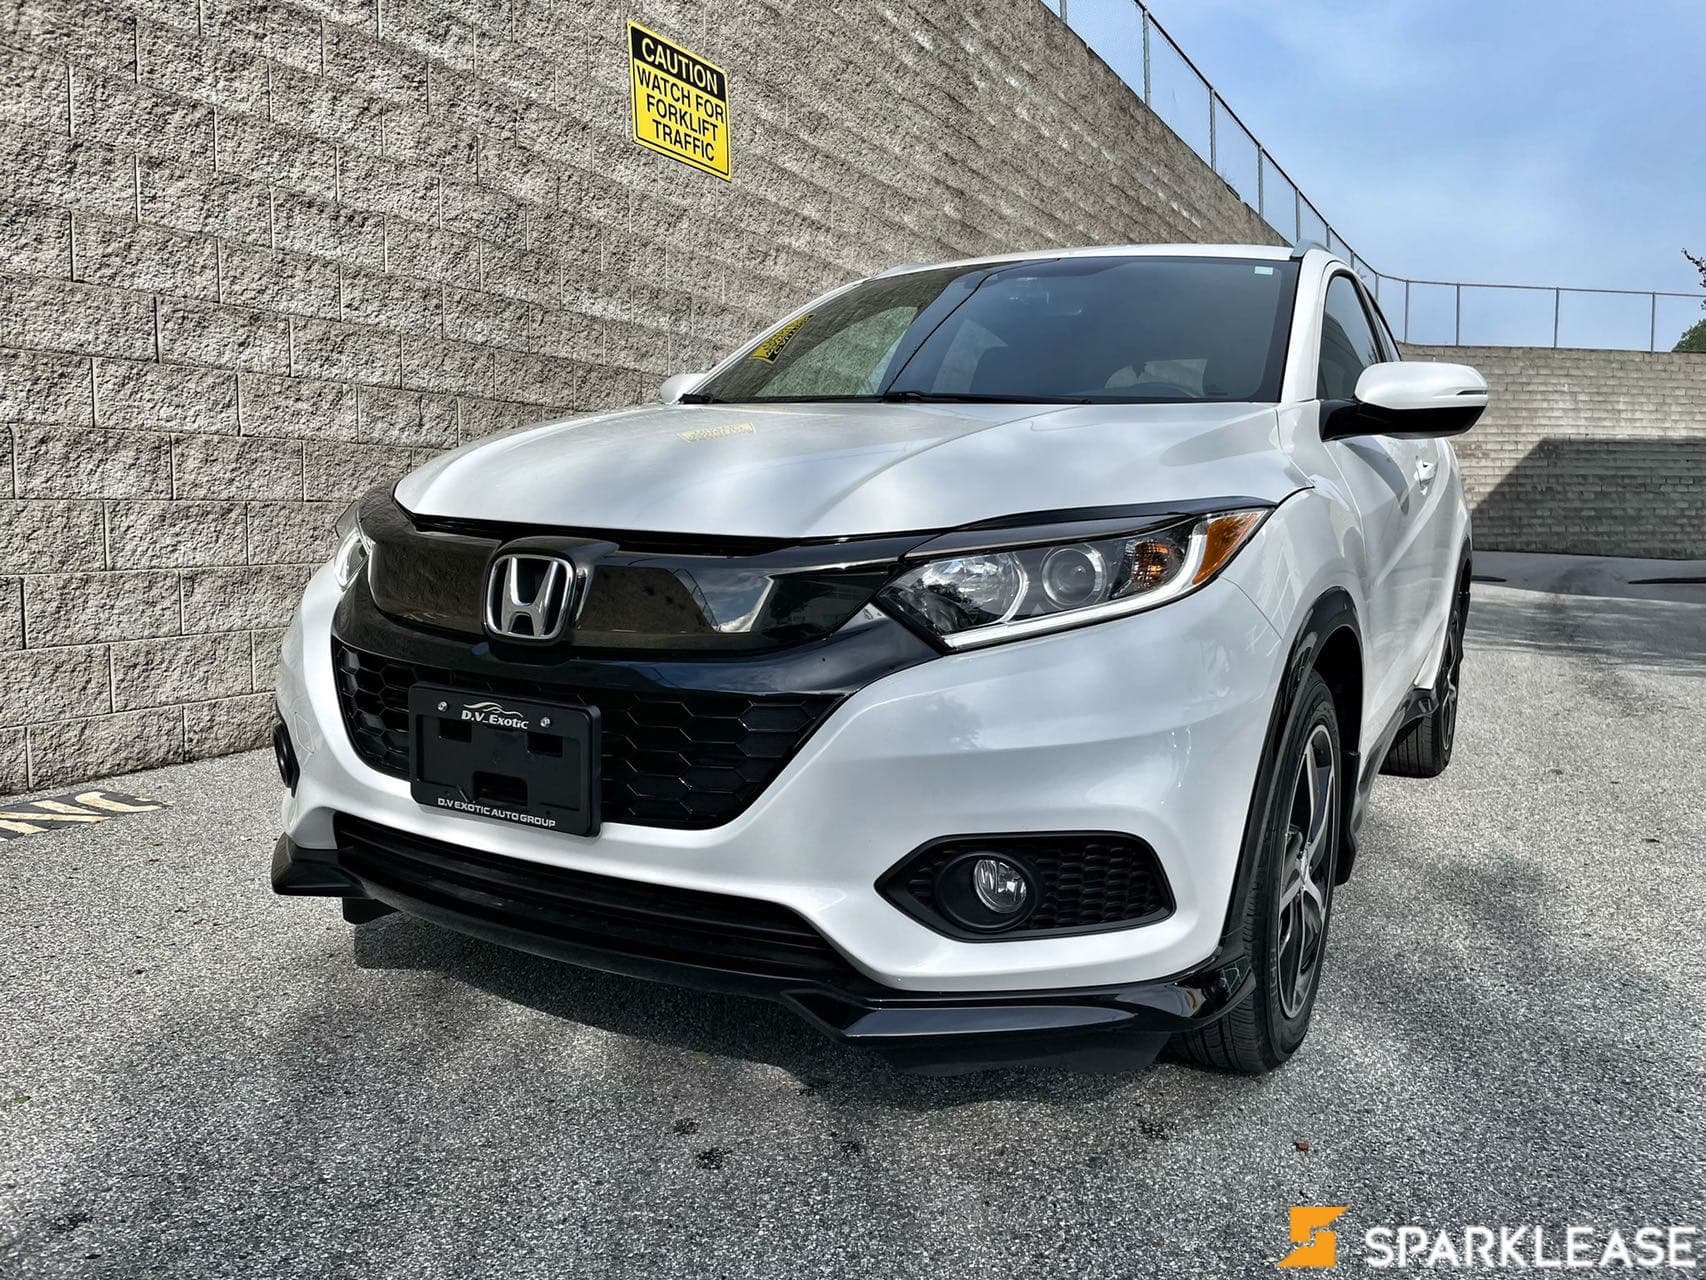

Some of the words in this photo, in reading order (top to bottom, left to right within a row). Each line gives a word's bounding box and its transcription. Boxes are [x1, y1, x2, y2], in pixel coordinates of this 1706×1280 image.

[642, 37, 718, 95] CAUTION
[636, 65, 692, 108] WATCH
[695, 93, 725, 124] FOR
[646, 93, 718, 141] FORKLIFT
[652, 118, 715, 162] TRAFFIC
[437, 798, 454, 808] D.V
[454, 801, 491, 815] EXOTIC
[491, 808, 519, 821] AUTO
[520, 814, 556, 827] GROUP
